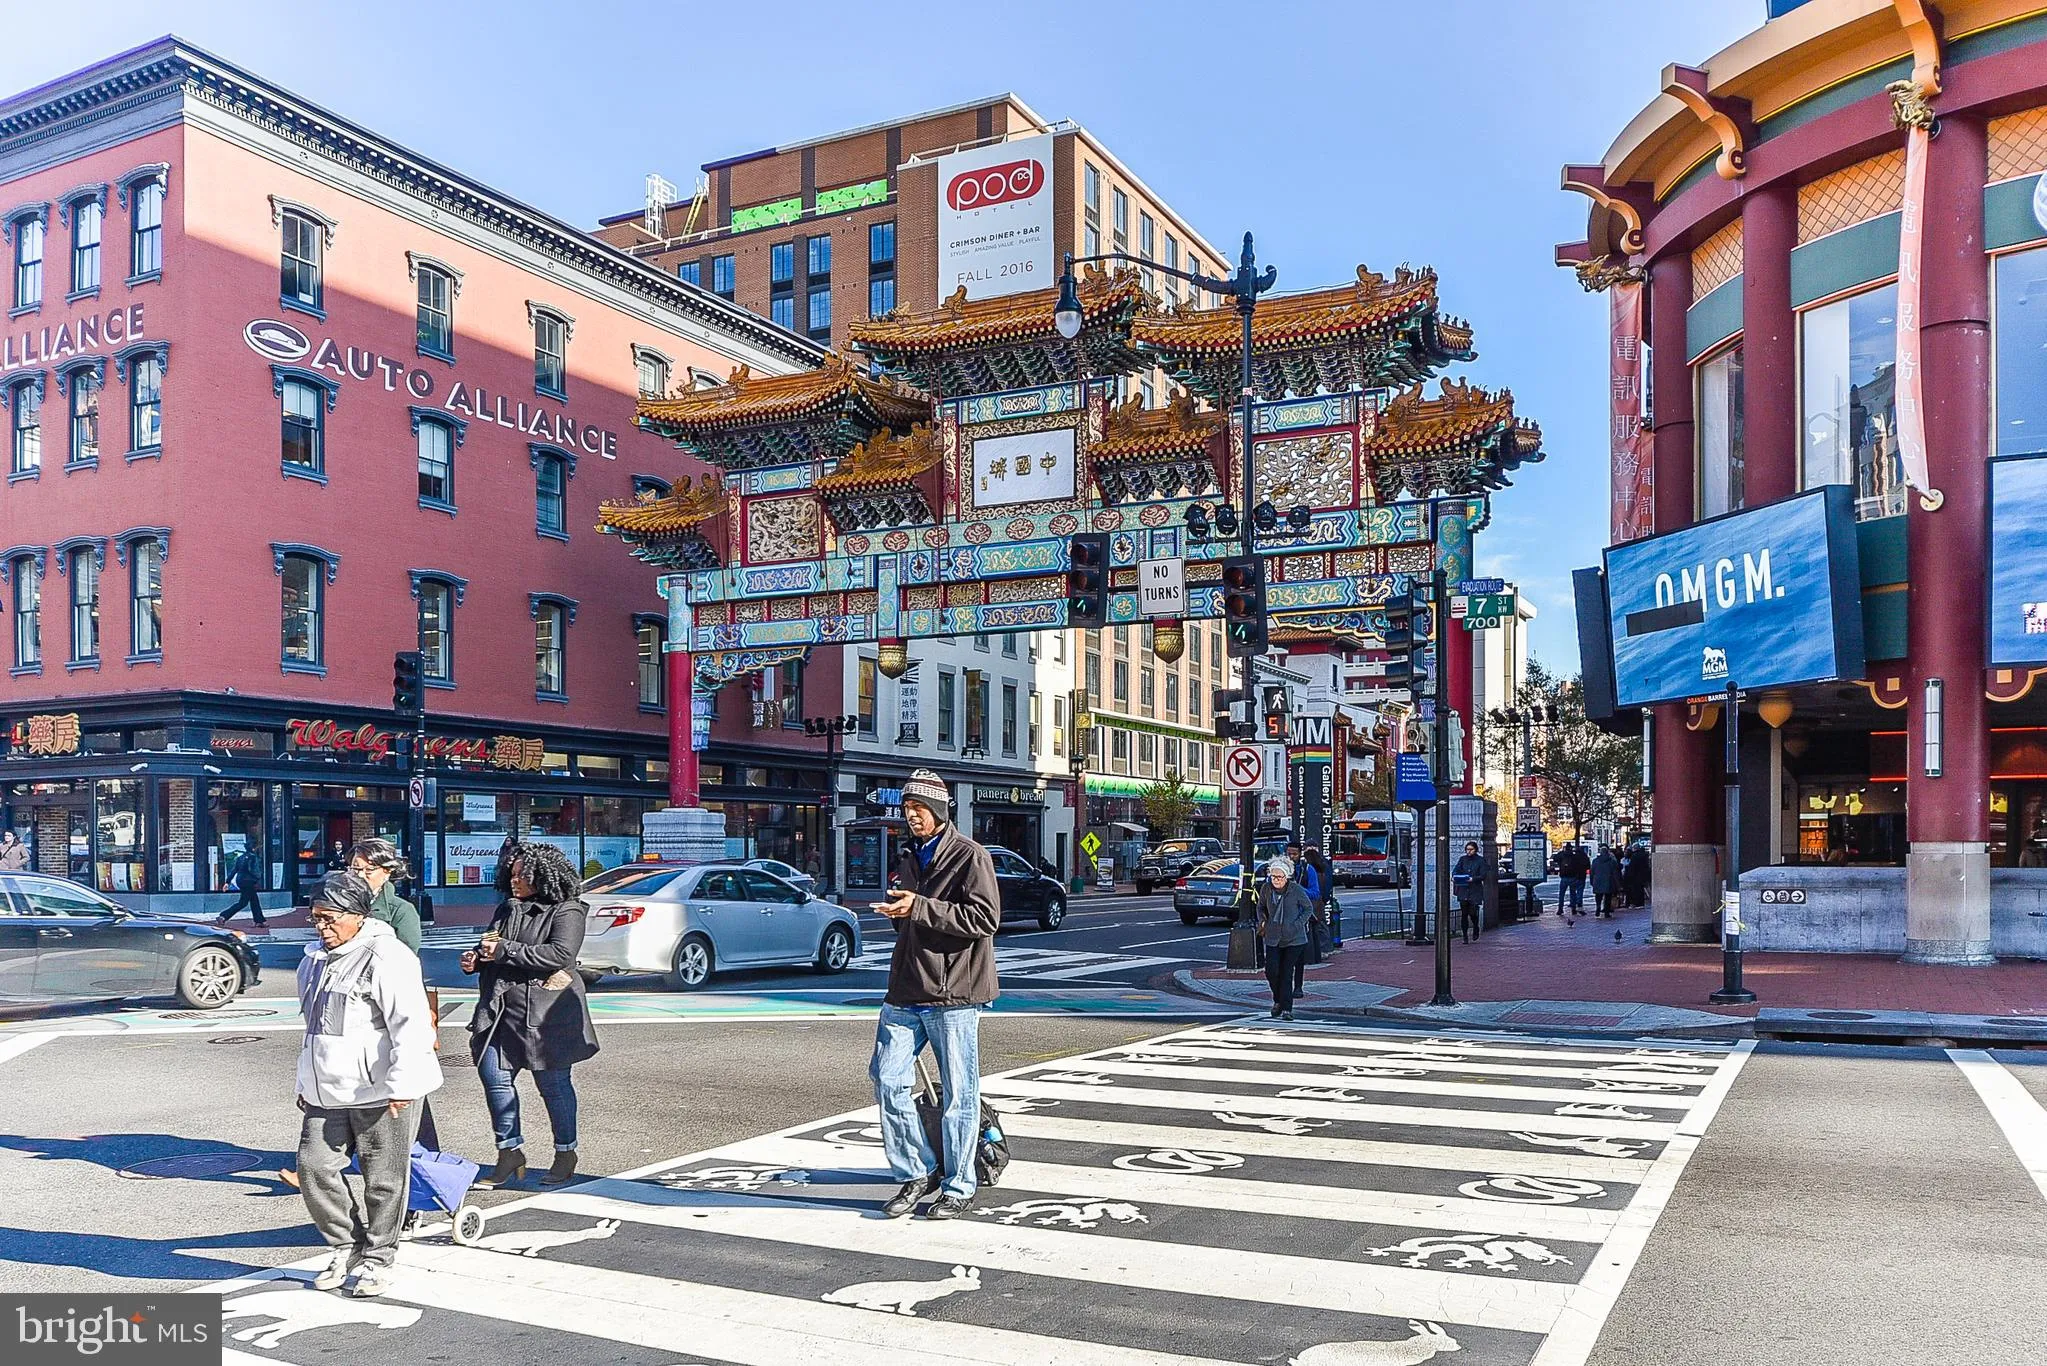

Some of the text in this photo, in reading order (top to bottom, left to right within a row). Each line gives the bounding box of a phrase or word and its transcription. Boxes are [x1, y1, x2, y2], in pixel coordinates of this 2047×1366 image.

[957, 159, 1033, 211] pod
[957, 201, 1032, 220] HOTEL
[949, 236, 987, 249] CRIMSON
[989, 230, 1014, 242] DINER
[1023, 226, 1040, 235] BAR
[950, 249, 969, 257] STYLISH
[974, 244, 997, 252] AMAZING
[998, 241, 1014, 249] VALUE
[957, 260, 1034, 283] FALL 2016
[0, 302, 144, 370] LLIANCE
[311, 338, 618, 460] AUTO ALLIANCE
[1153, 565, 1168, 578] NO
[1144, 586, 1179, 601] TURNS
[1488, 580, 1502, 591] ROUTE
[1475, 597, 1507, 614] 7 ST
[1466, 616, 1497, 628] 700
[1702, 660, 1728, 674] MGM
[1708, 693, 1728, 702] BARREL
[28, 712, 82, 755] 藥房
[1306, 718, 1330, 744] M
[494, 735, 546, 771] 藥房
[1322, 765, 1332, 804] Gallery
[977, 789, 1044, 801] panera bread
[1520, 822, 1536, 832] 25
[450, 846, 500, 858] Walgreens
